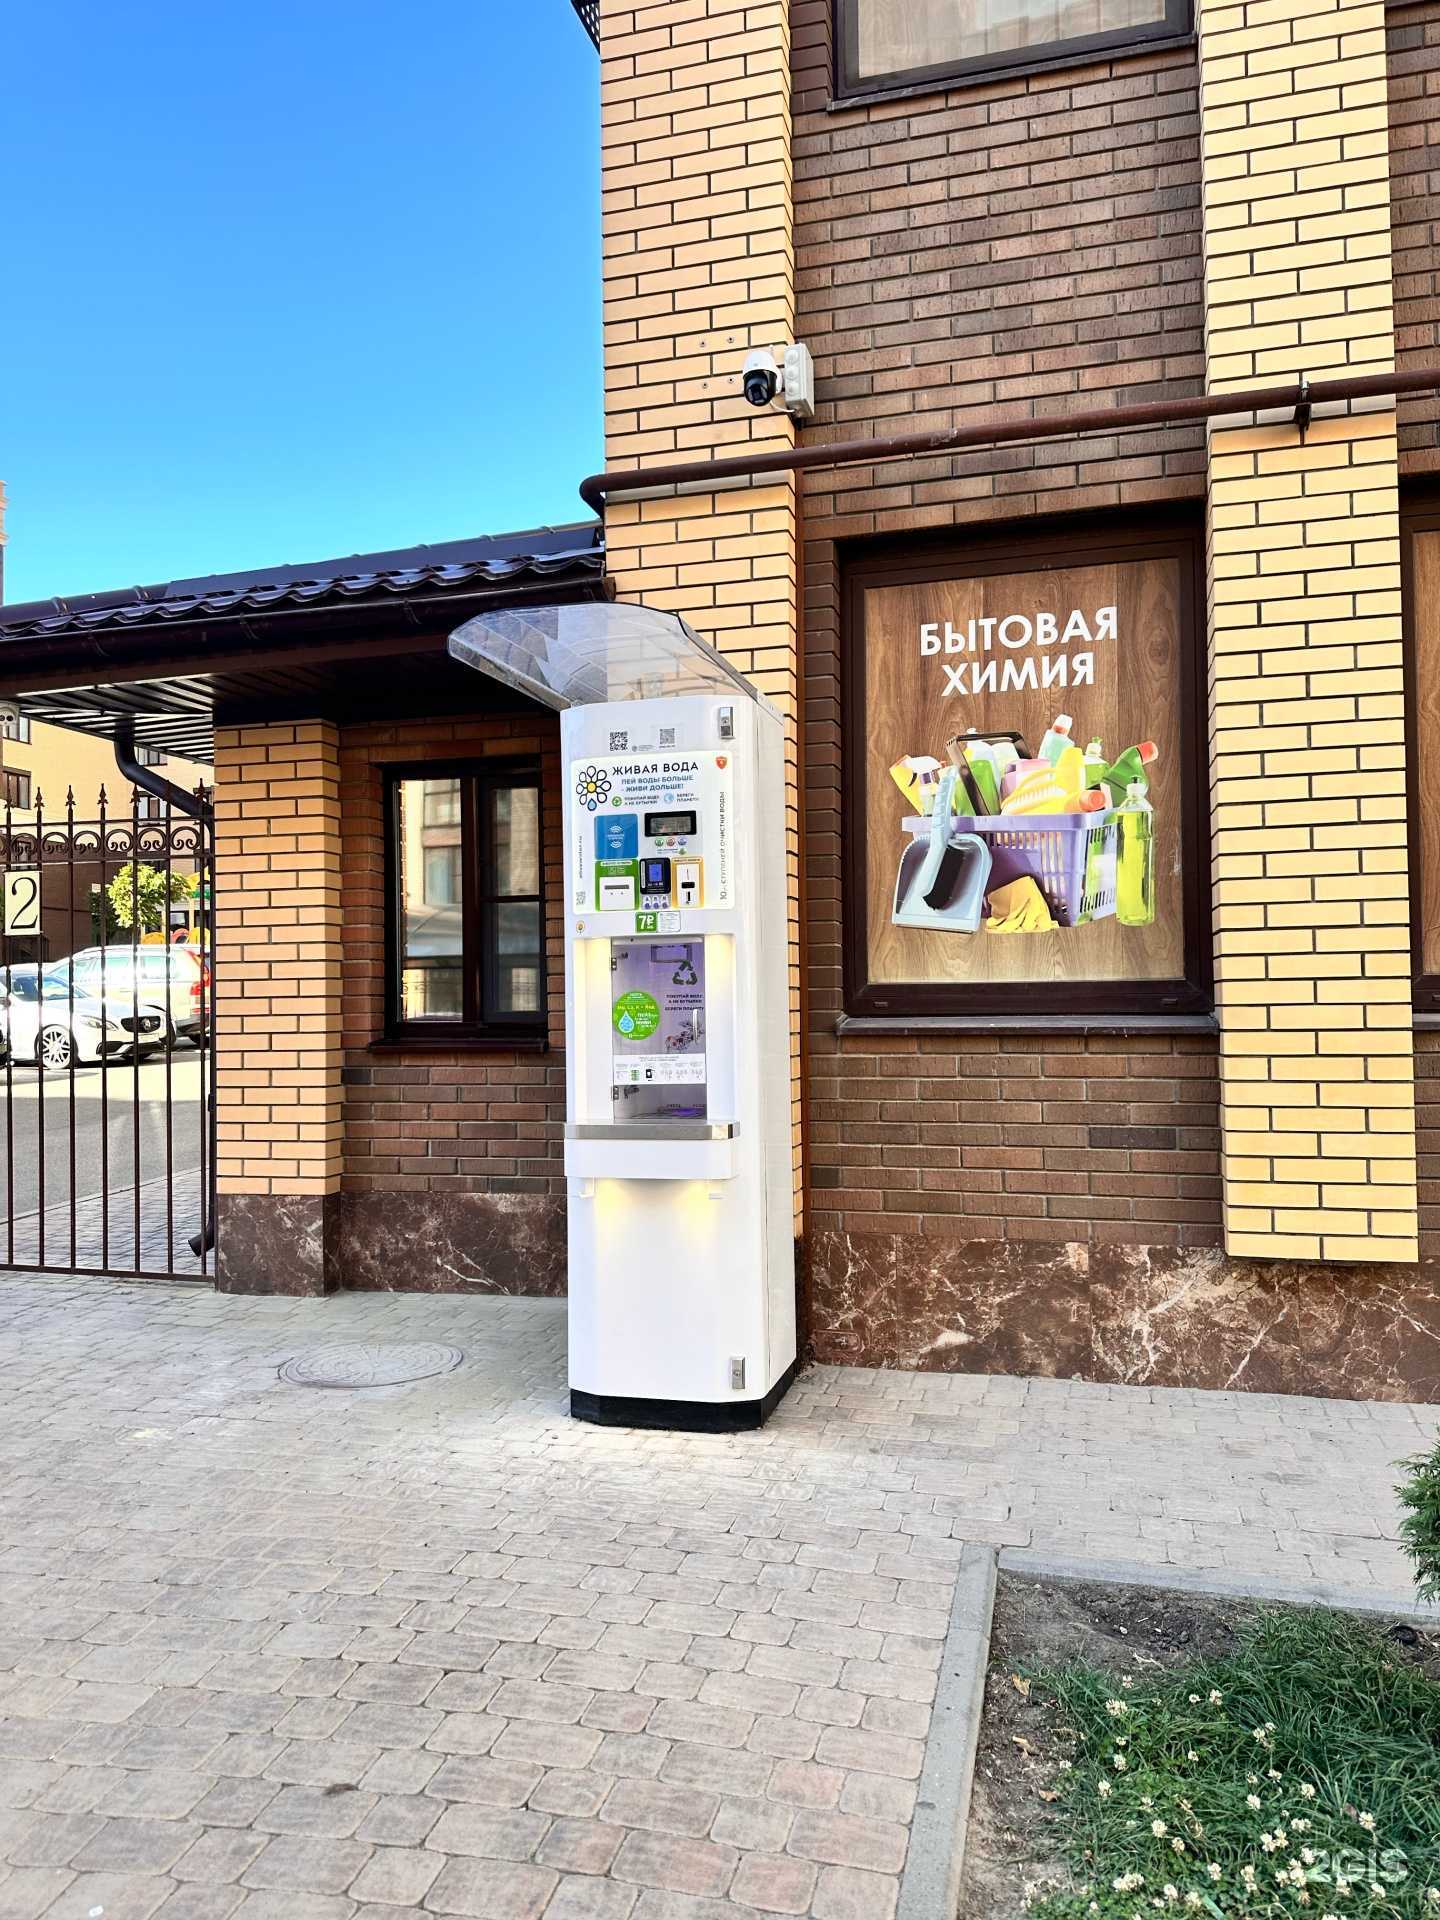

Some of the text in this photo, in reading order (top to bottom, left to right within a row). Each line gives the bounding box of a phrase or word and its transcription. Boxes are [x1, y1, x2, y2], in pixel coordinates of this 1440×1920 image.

[920, 606, 1118, 656] БЫТОВАЯ
[941, 652, 1094, 697] ХИМИЯ
[612, 762, 699, 776] ЖИВАЯ ВОДА
[638, 777, 660, 785] ВОДЫ
[662, 775, 694, 783] БОЛЬШЕ
[626, 785, 648, 793] ЖИВИ
[10, 876, 38, 930] 2
